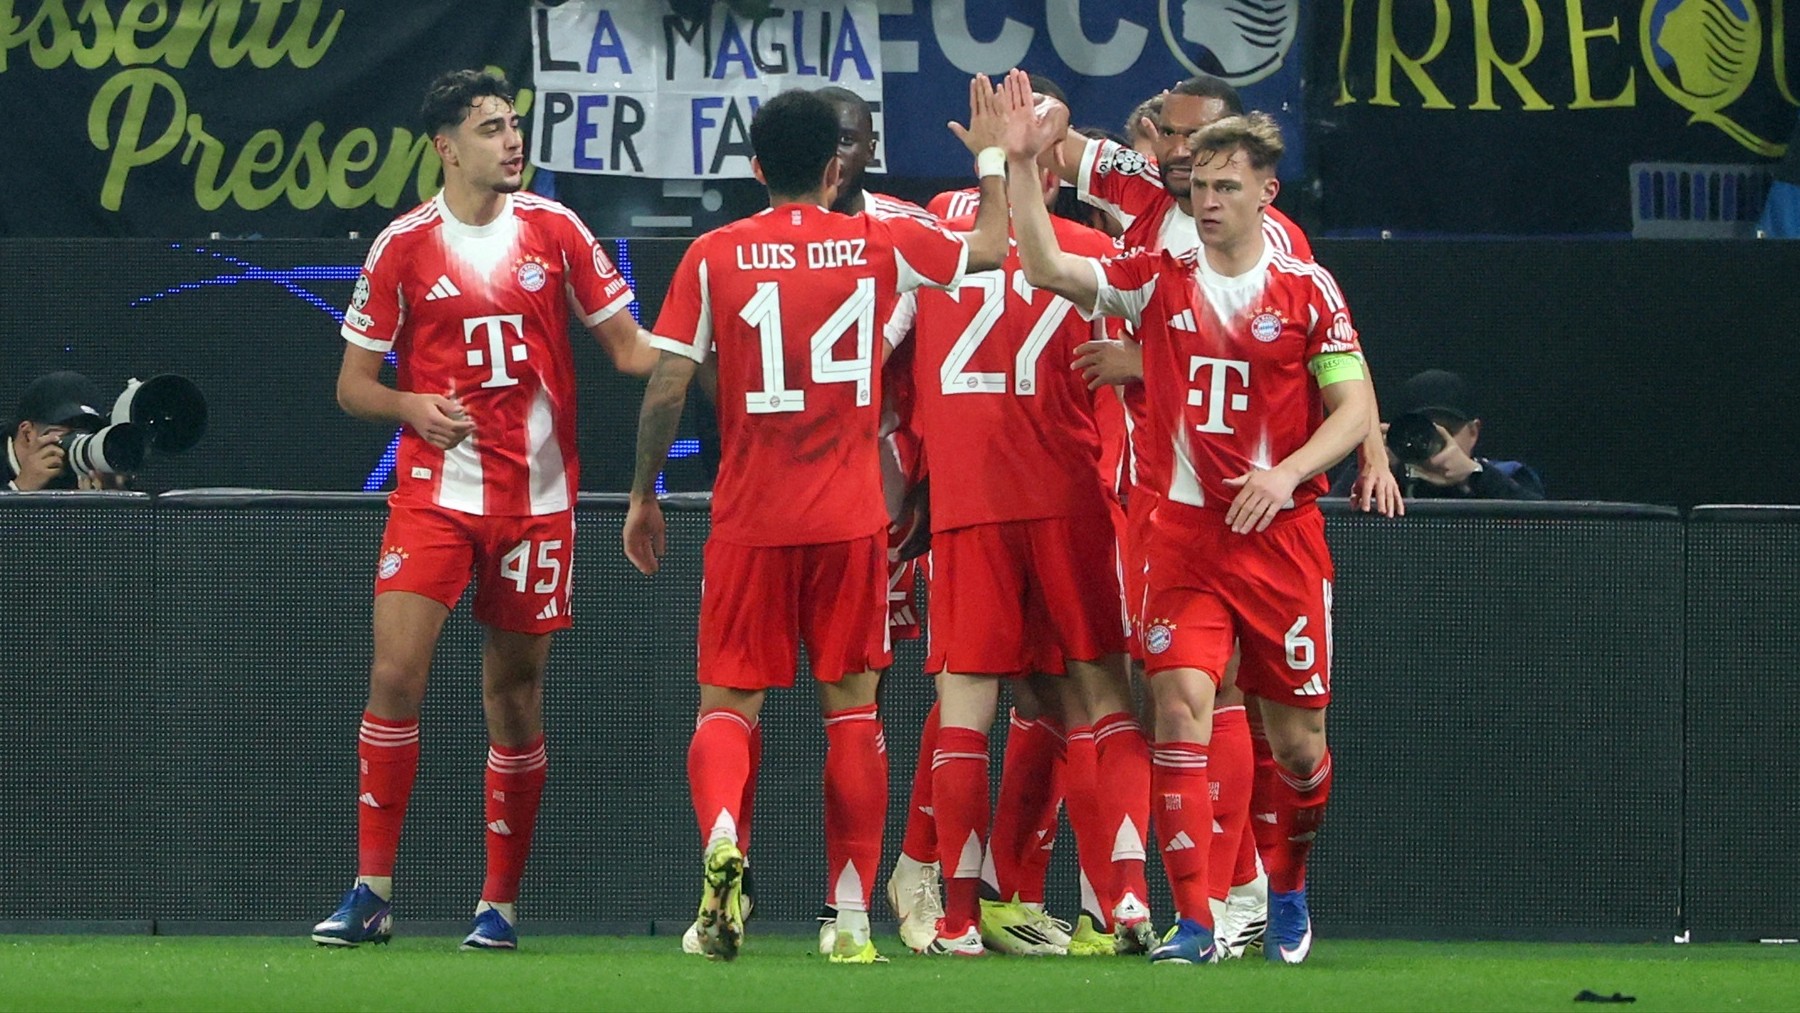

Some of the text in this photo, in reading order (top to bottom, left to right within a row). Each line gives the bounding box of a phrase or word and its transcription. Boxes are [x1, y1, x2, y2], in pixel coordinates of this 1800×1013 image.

[537, 5, 874, 81] LA MAGLIA
[88, 66, 538, 211] Presen
[540, 92, 646, 173] PER
[736, 239, 868, 270] LUIS DÍAZ
[738, 276, 876, 414] 14
[940, 268, 1075, 396] 27
[500, 540, 563, 594] 45
[1285, 616, 1315, 670] 6
